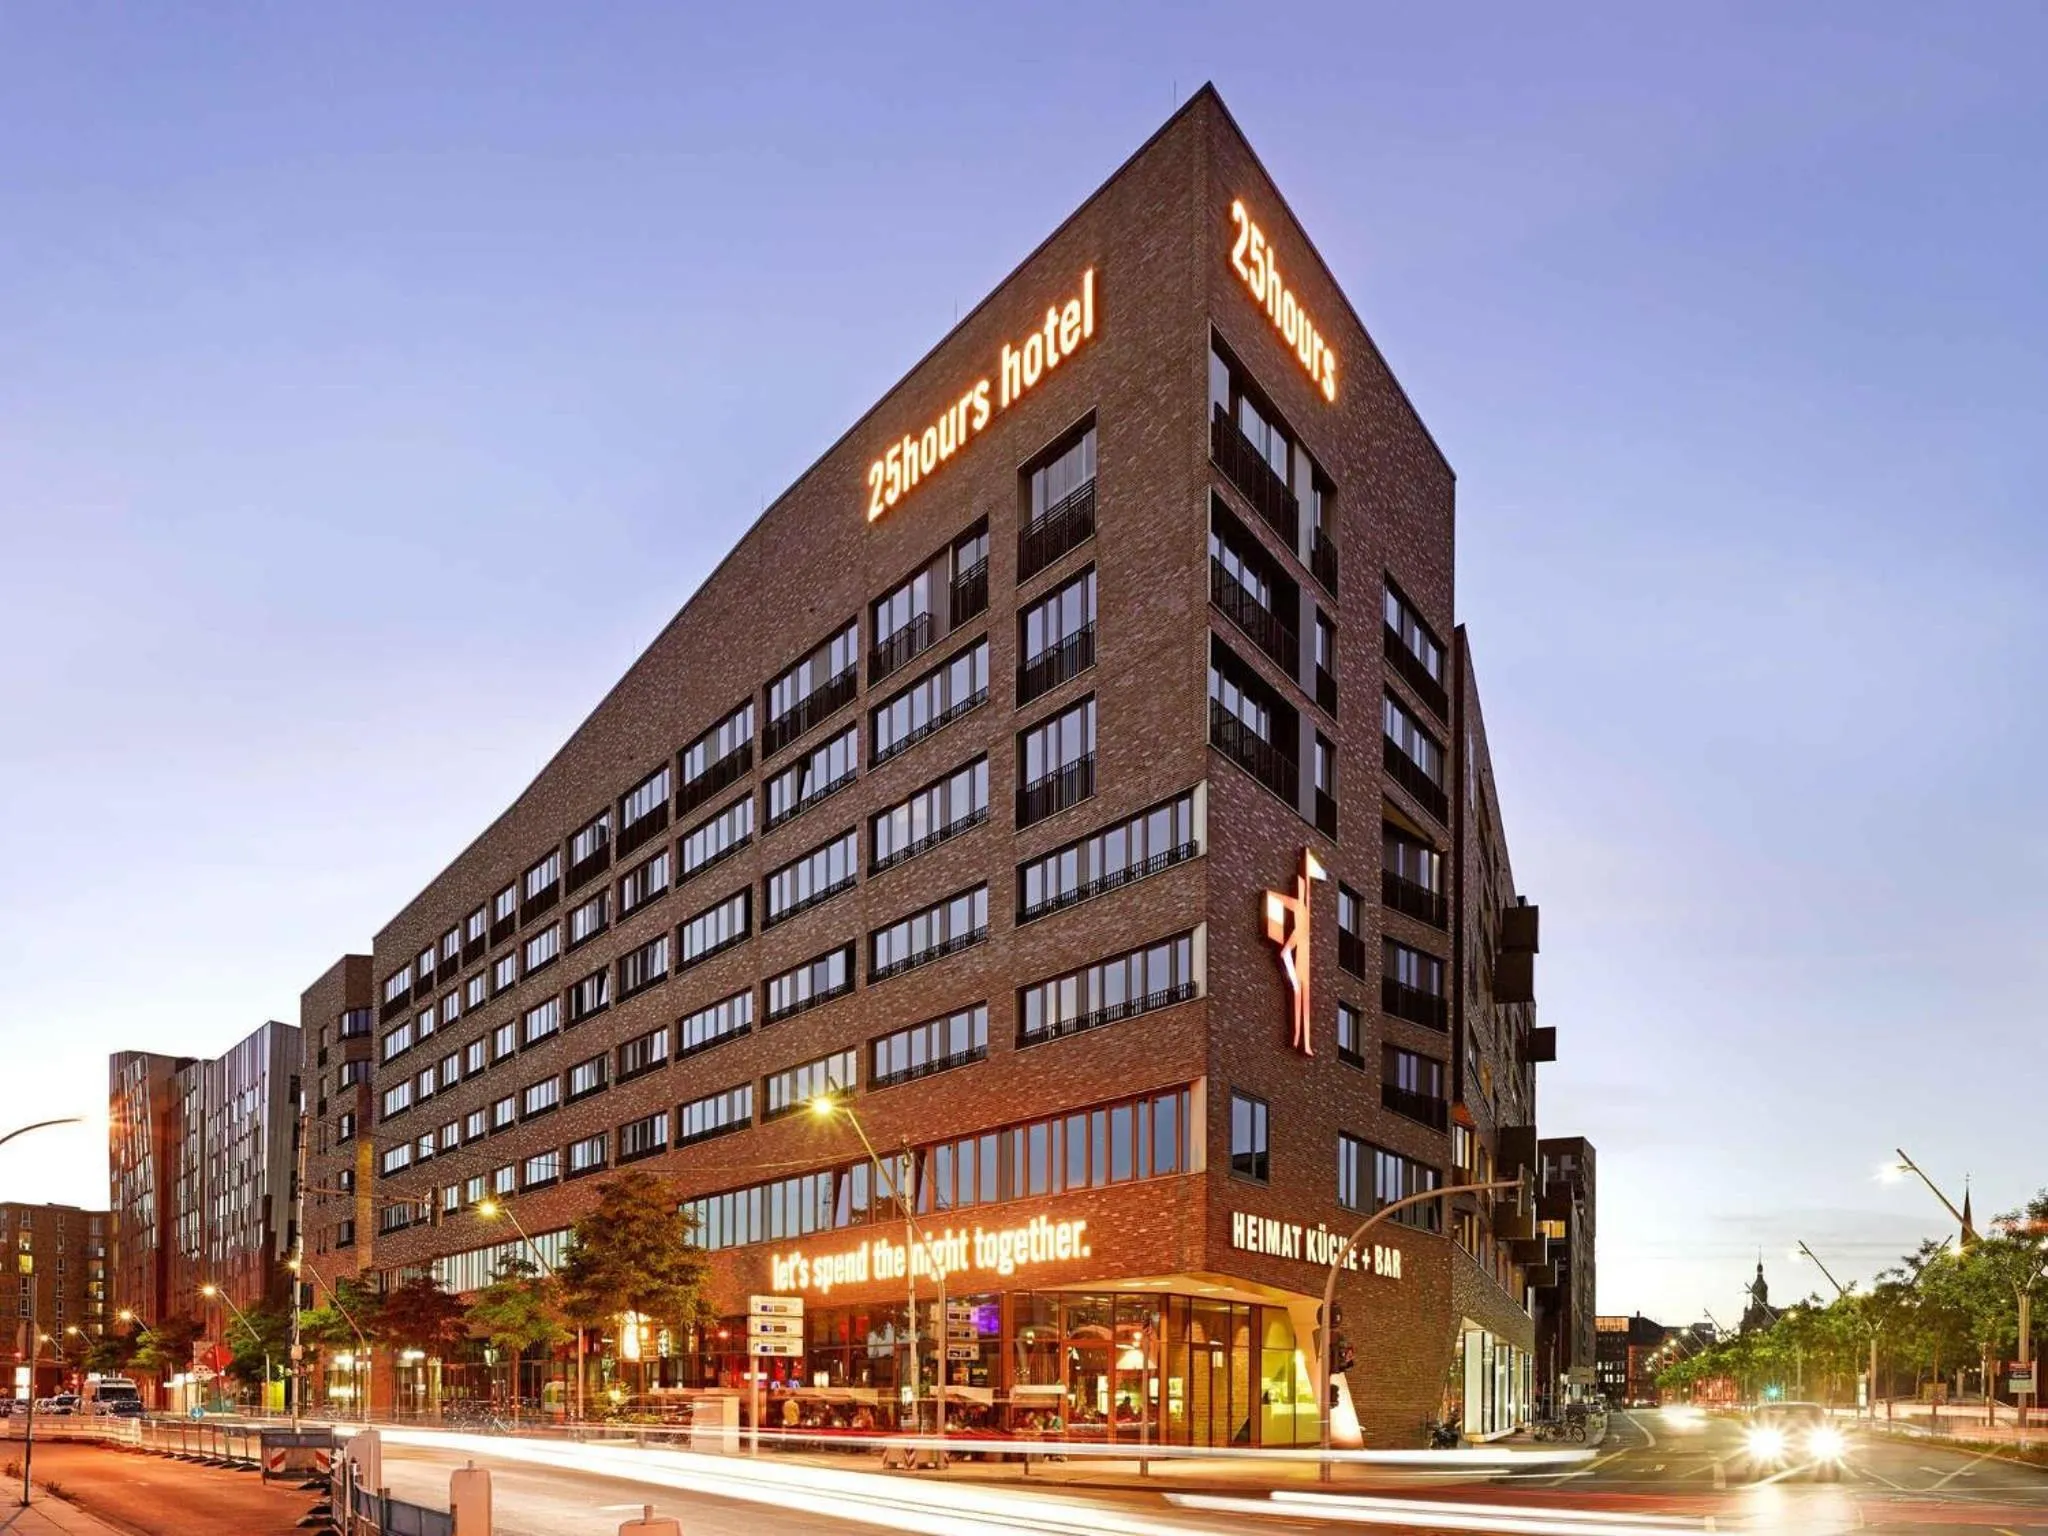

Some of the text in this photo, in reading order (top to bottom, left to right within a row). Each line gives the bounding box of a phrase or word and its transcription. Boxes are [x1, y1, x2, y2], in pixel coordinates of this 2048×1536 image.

[1232, 200, 1335, 402] 25hours
[867, 267, 1094, 522] 25hours hotel
[772, 1215, 1091, 1294] let's spend the night together.
[1233, 1211, 1302, 1260] HEIMAT
[1374, 1245, 1402, 1280] BAR
